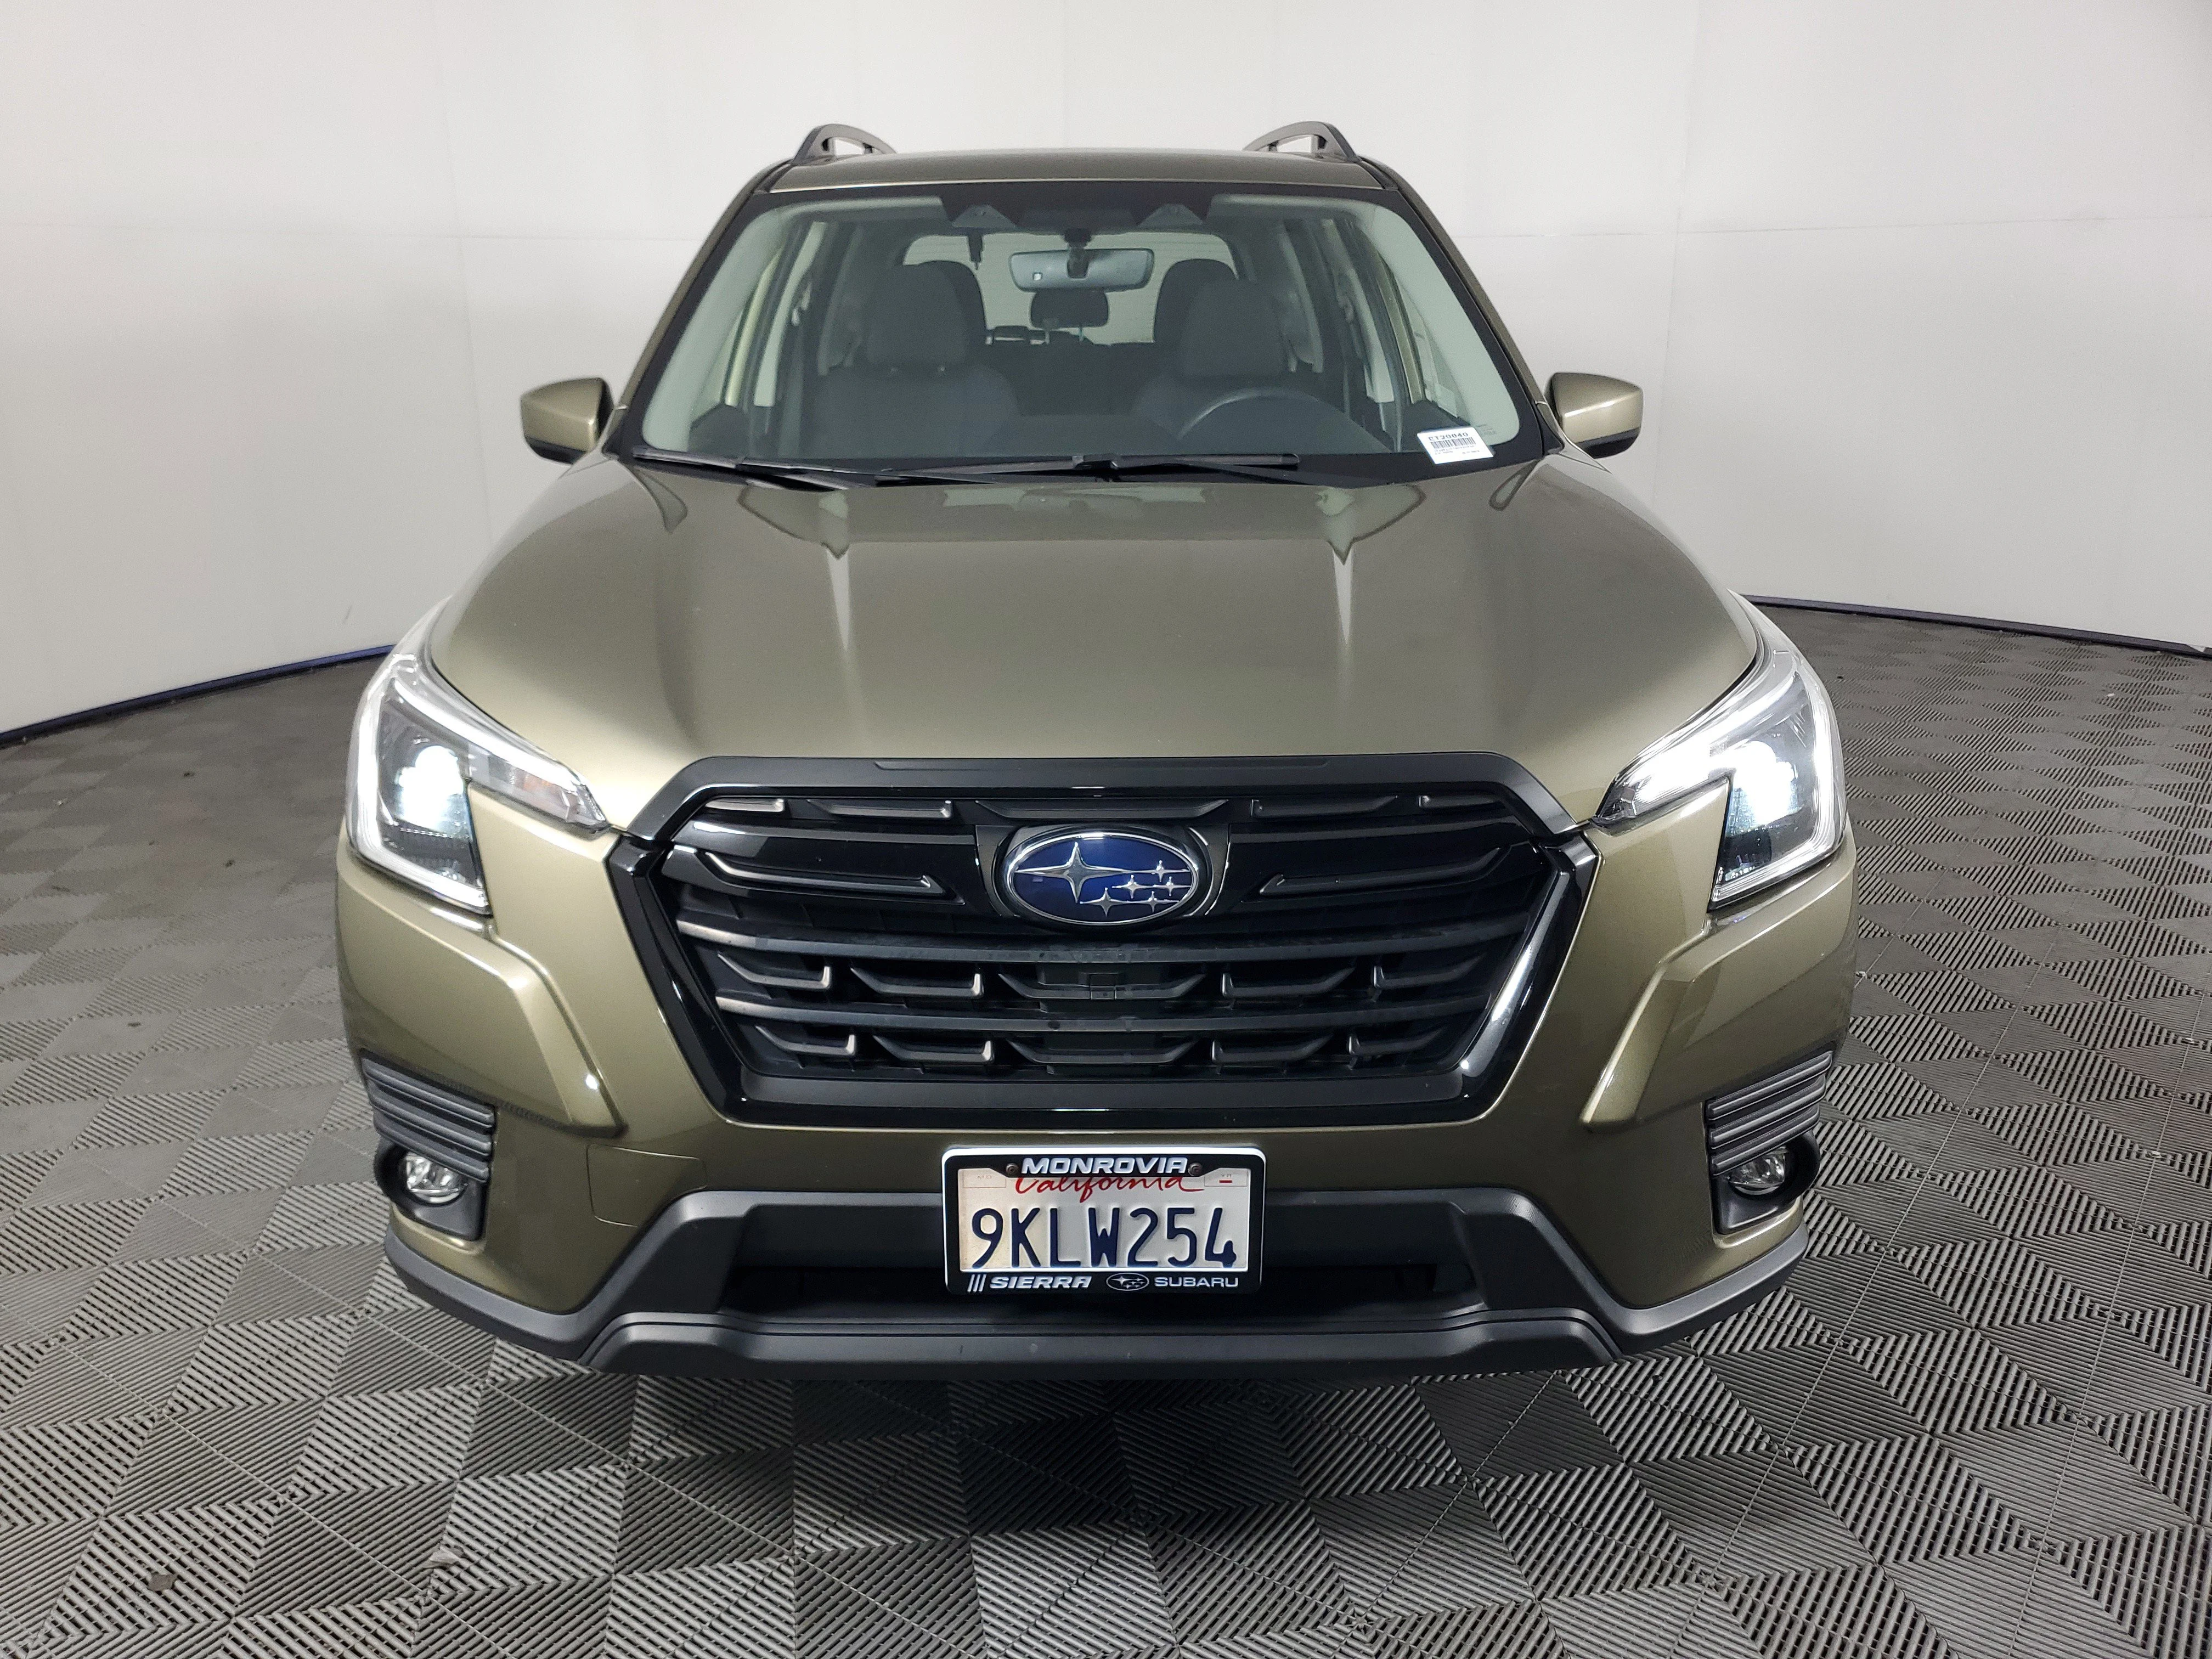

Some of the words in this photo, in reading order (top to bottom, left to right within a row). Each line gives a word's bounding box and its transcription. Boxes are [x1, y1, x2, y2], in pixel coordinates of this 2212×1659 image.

[1021, 1157, 1188, 1175] MONROVIA
[971, 1207, 1237, 1269] 9KLW254
[989, 1276, 1092, 1289] SIERRA
[1154, 1277, 1239, 1288] SUBARU
